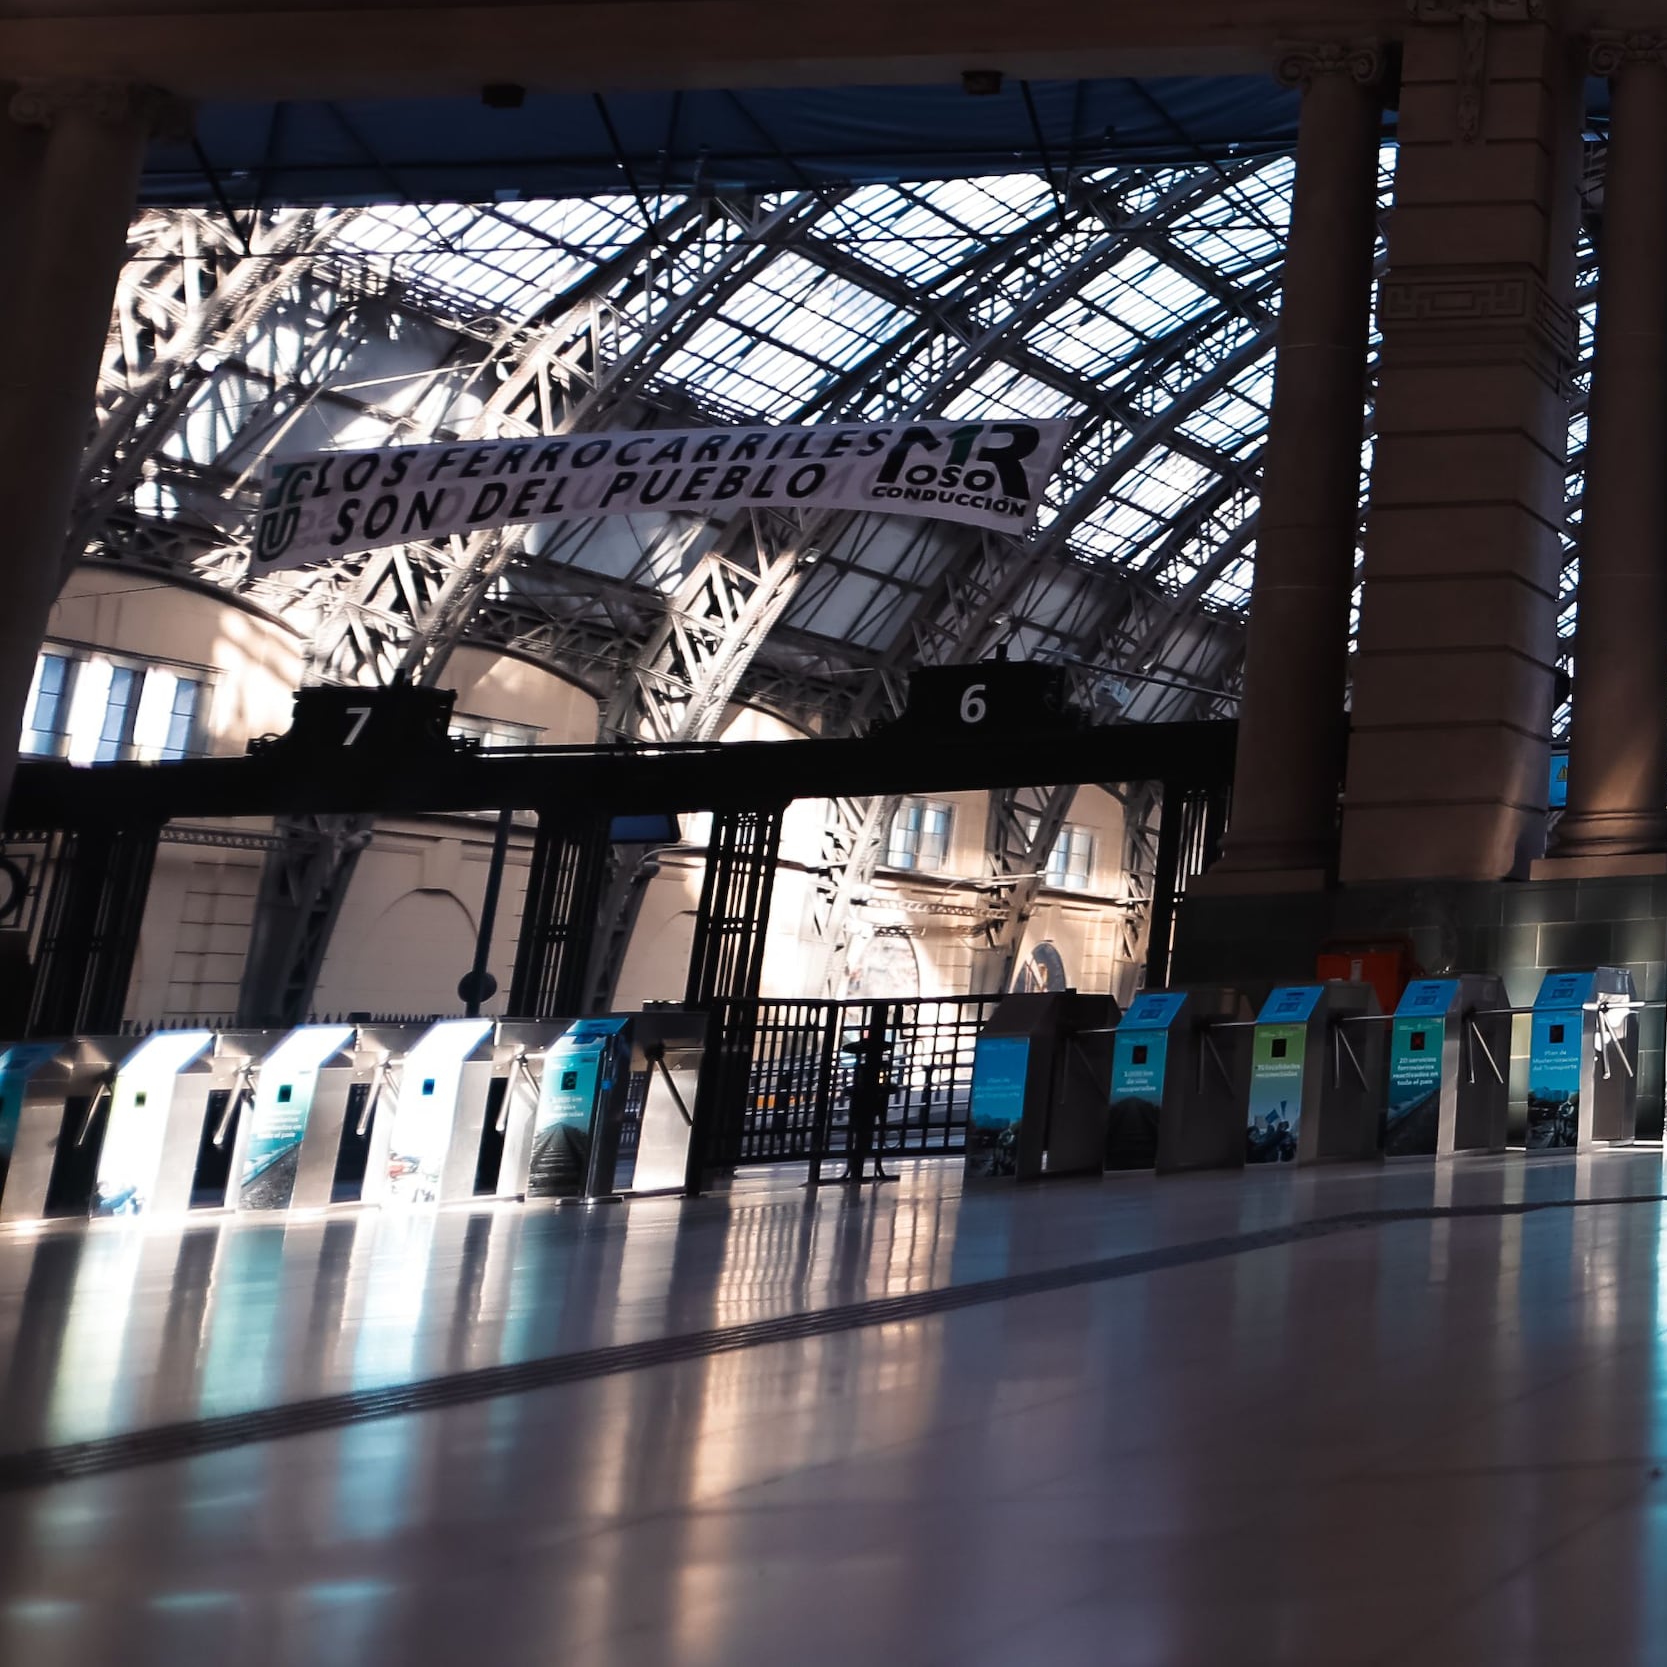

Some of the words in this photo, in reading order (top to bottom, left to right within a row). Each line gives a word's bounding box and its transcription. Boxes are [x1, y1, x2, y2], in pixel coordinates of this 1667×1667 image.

[311, 450, 418, 498] LOS
[427, 428, 893, 482] FERROCARRILES
[330, 487, 447, 546] SON
[466, 476, 568, 524] DEL
[598, 462, 827, 508] PUEBLO
[871, 484, 1027, 517] CONDUCCIÓN
[958, 683, 987, 723] 6
[343, 707, 373, 746] 7
